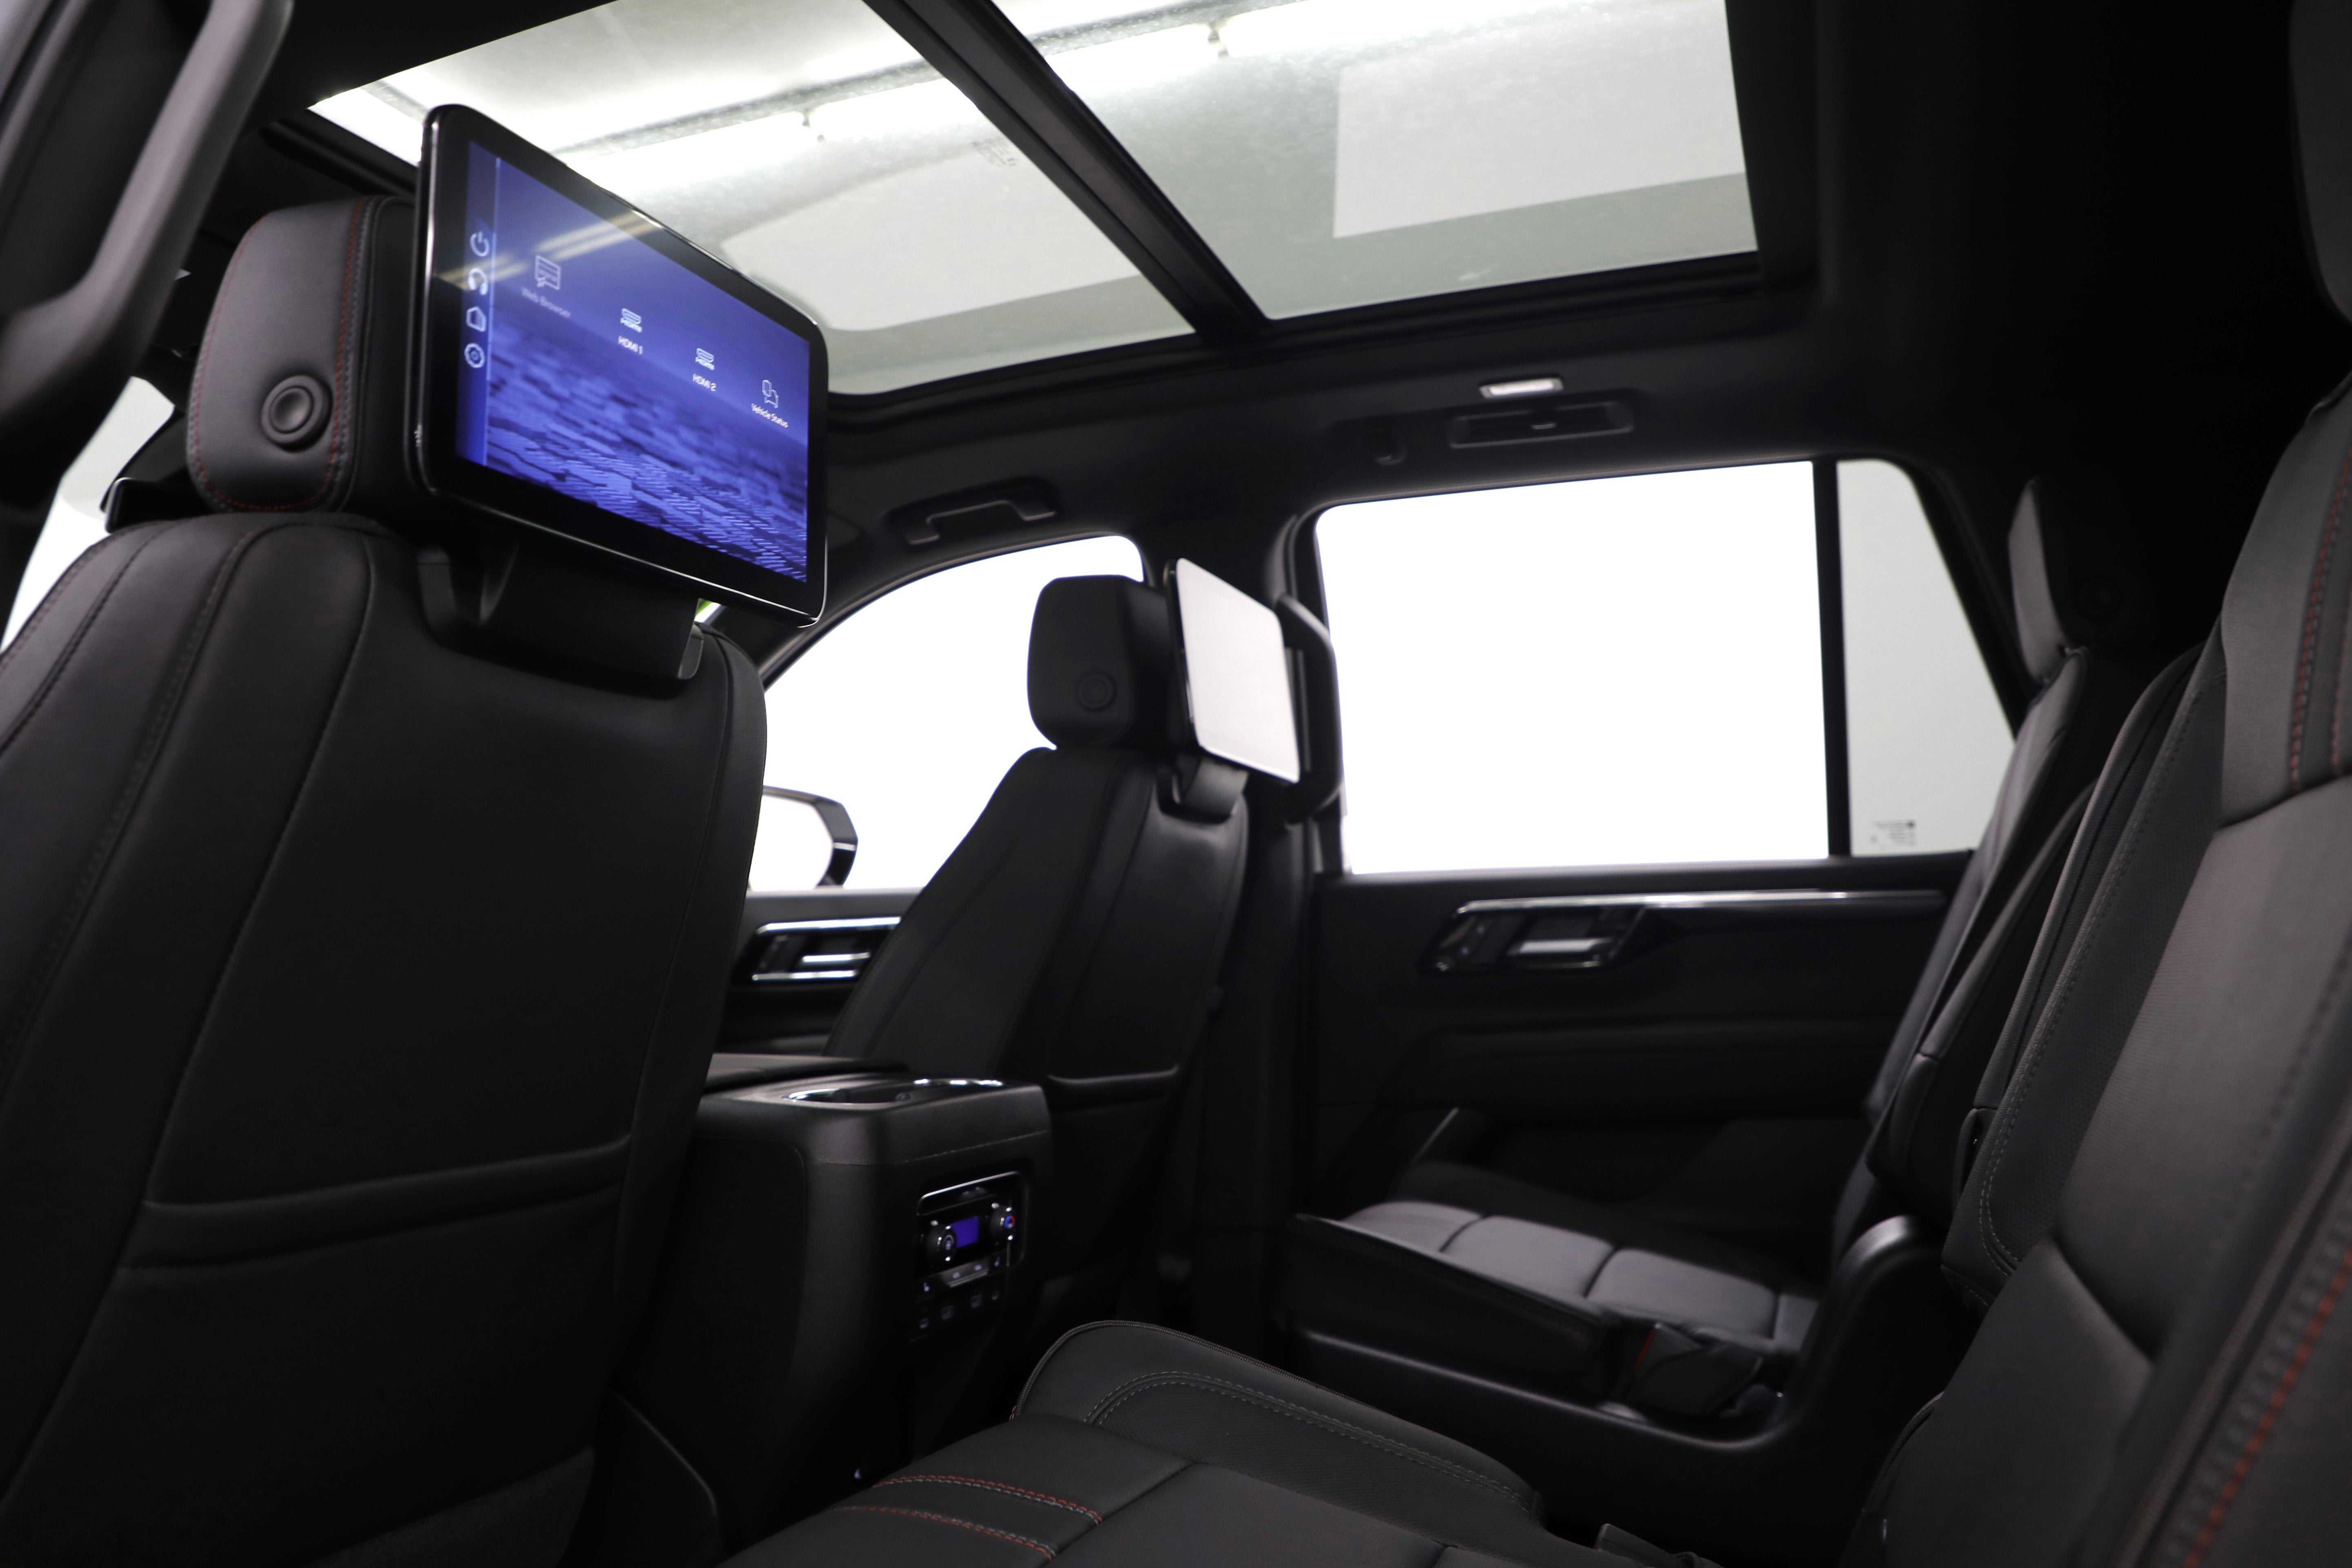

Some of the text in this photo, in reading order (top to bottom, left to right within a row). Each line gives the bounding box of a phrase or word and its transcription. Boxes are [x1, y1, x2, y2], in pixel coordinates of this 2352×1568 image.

[618, 335, 643, 355] HDMI 1
[693, 373, 716, 392] HDMI 2
[751, 403, 788, 428] Vehicle Status
